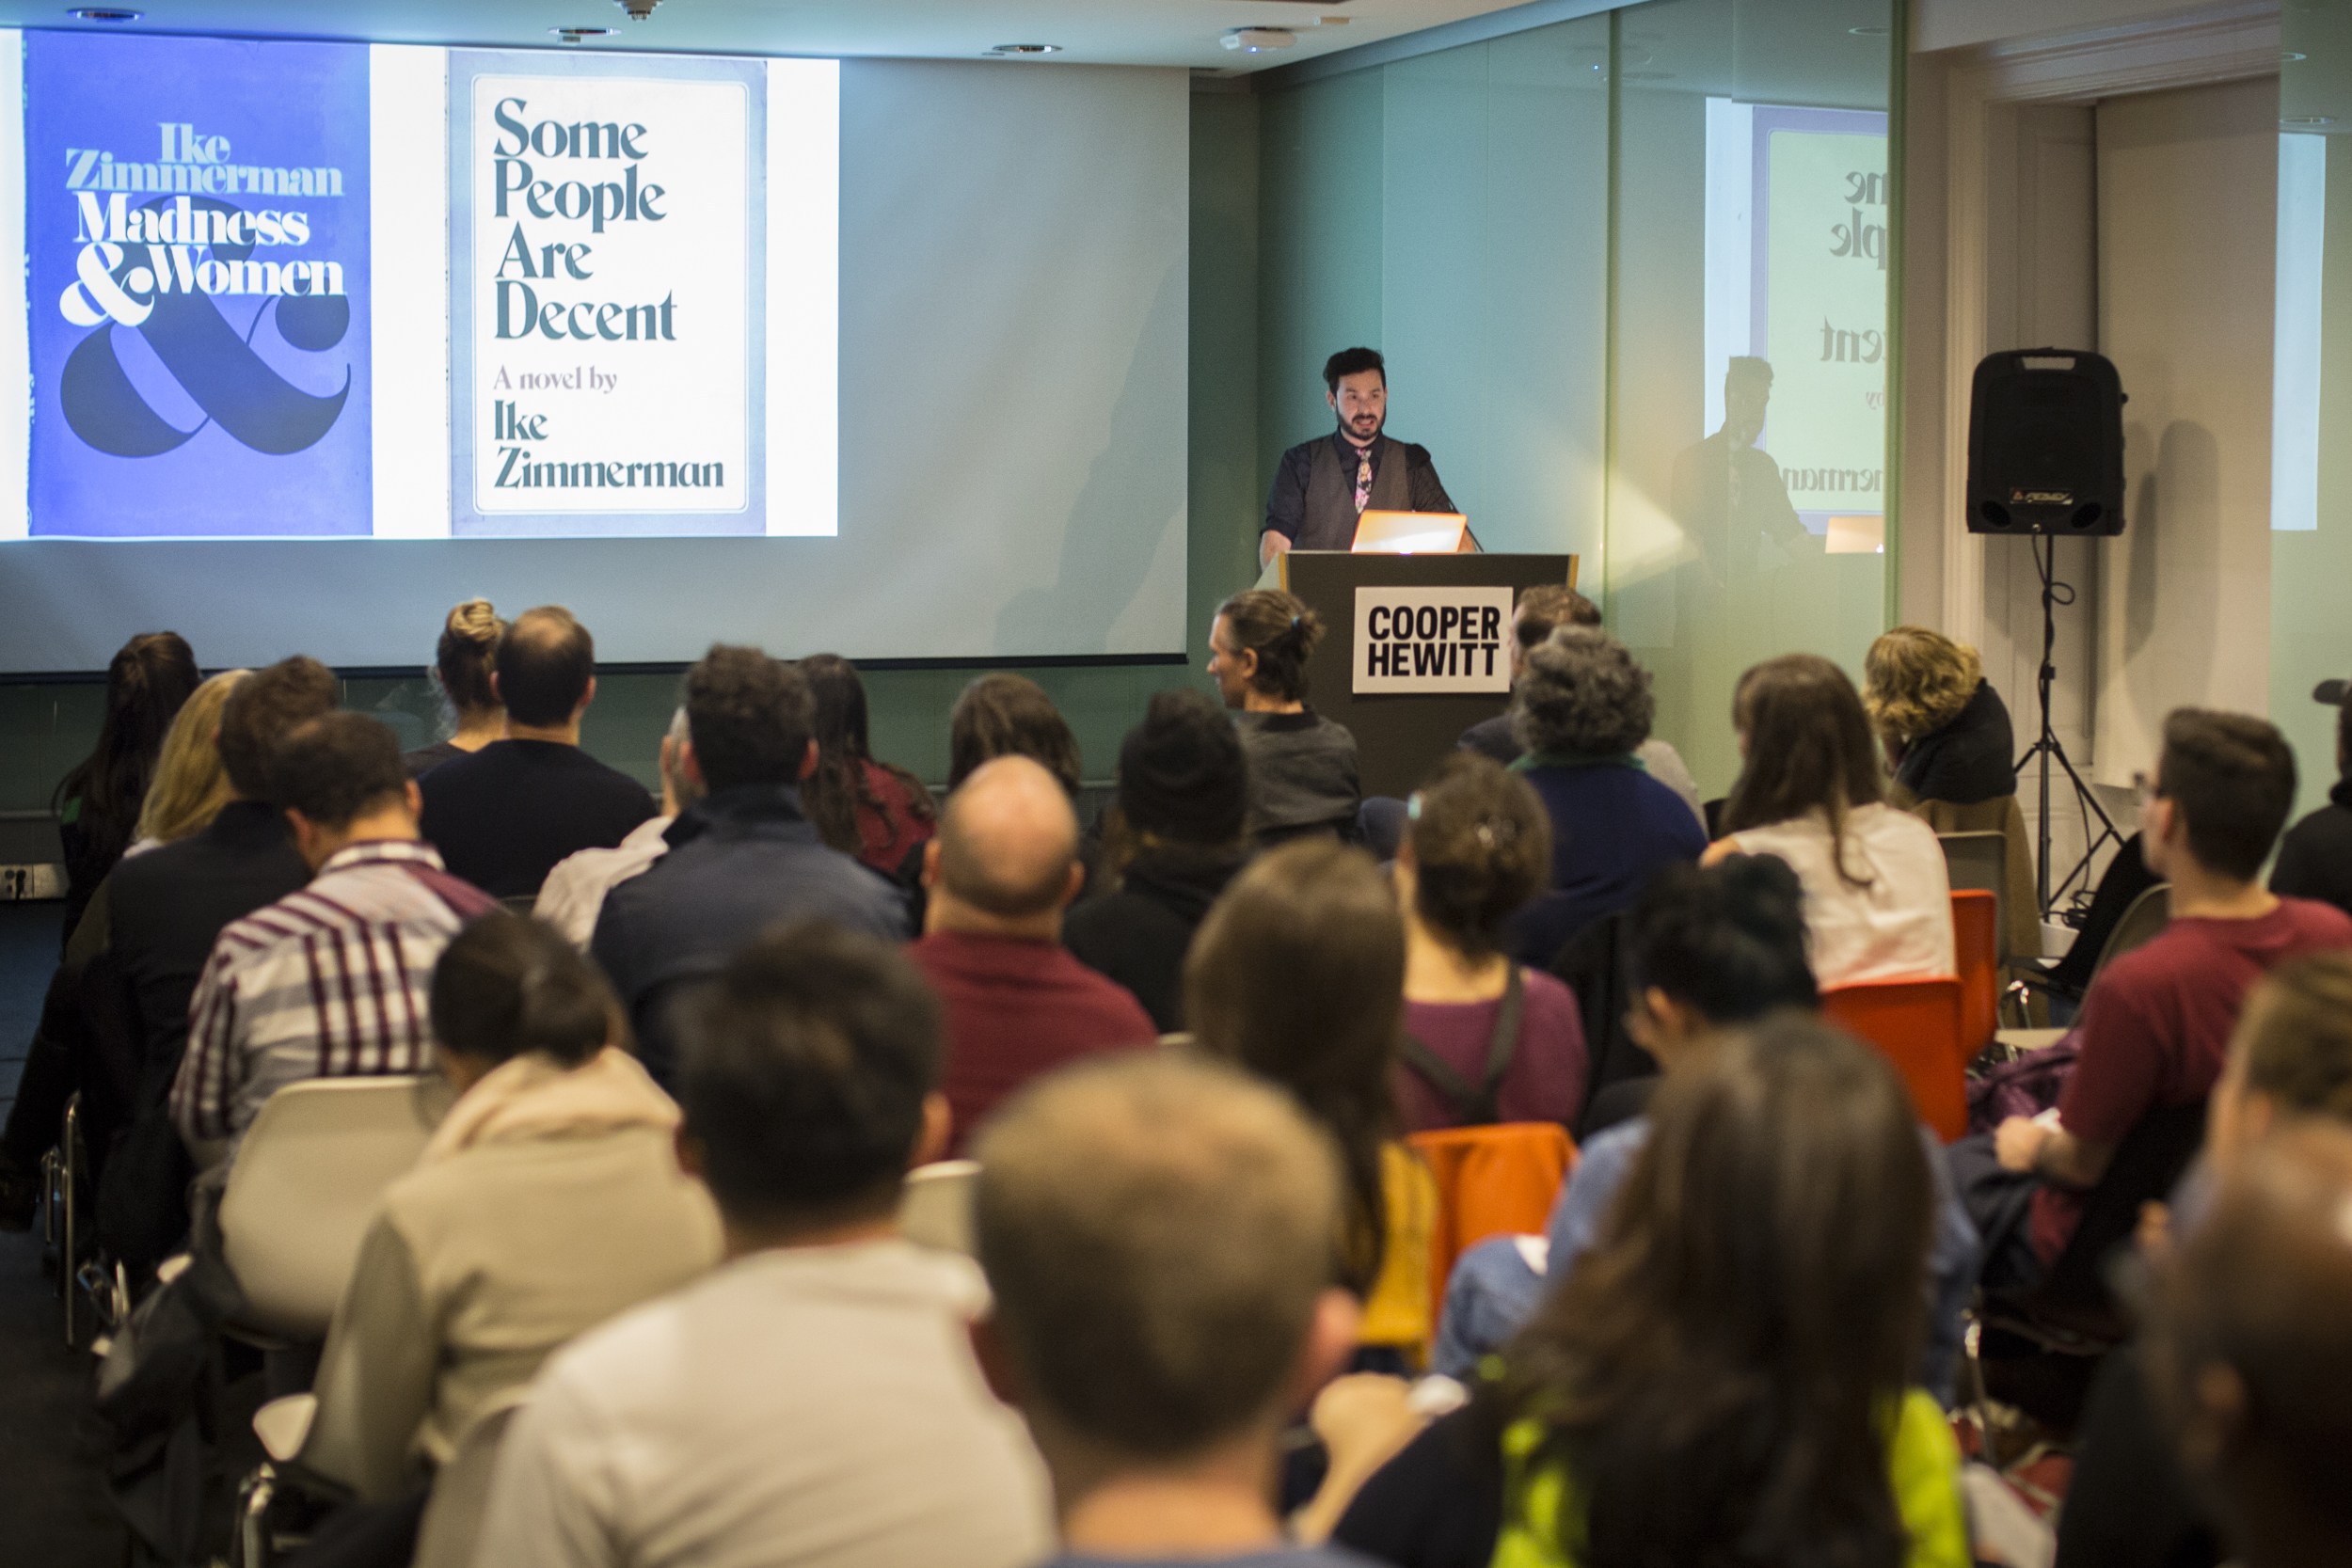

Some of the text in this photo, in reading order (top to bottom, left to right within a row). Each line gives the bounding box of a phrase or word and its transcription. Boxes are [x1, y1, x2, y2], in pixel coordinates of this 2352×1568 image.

[157, 123, 230, 166] Ike
[493, 98, 649, 159] Some
[65, 148, 345, 197] Zimmerman
[494, 158, 668, 233] People
[72, 191, 310, 246] Madness
[494, 220, 594, 280] Are
[494, 279, 677, 341] Decent
[493, 364, 617, 394] A novel by
[494, 400, 548, 440] Ike
[494, 445, 724, 489] Zimmerman
[1368, 605, 1501, 641] COOPER
[1368, 642, 1500, 676] HEWITT
